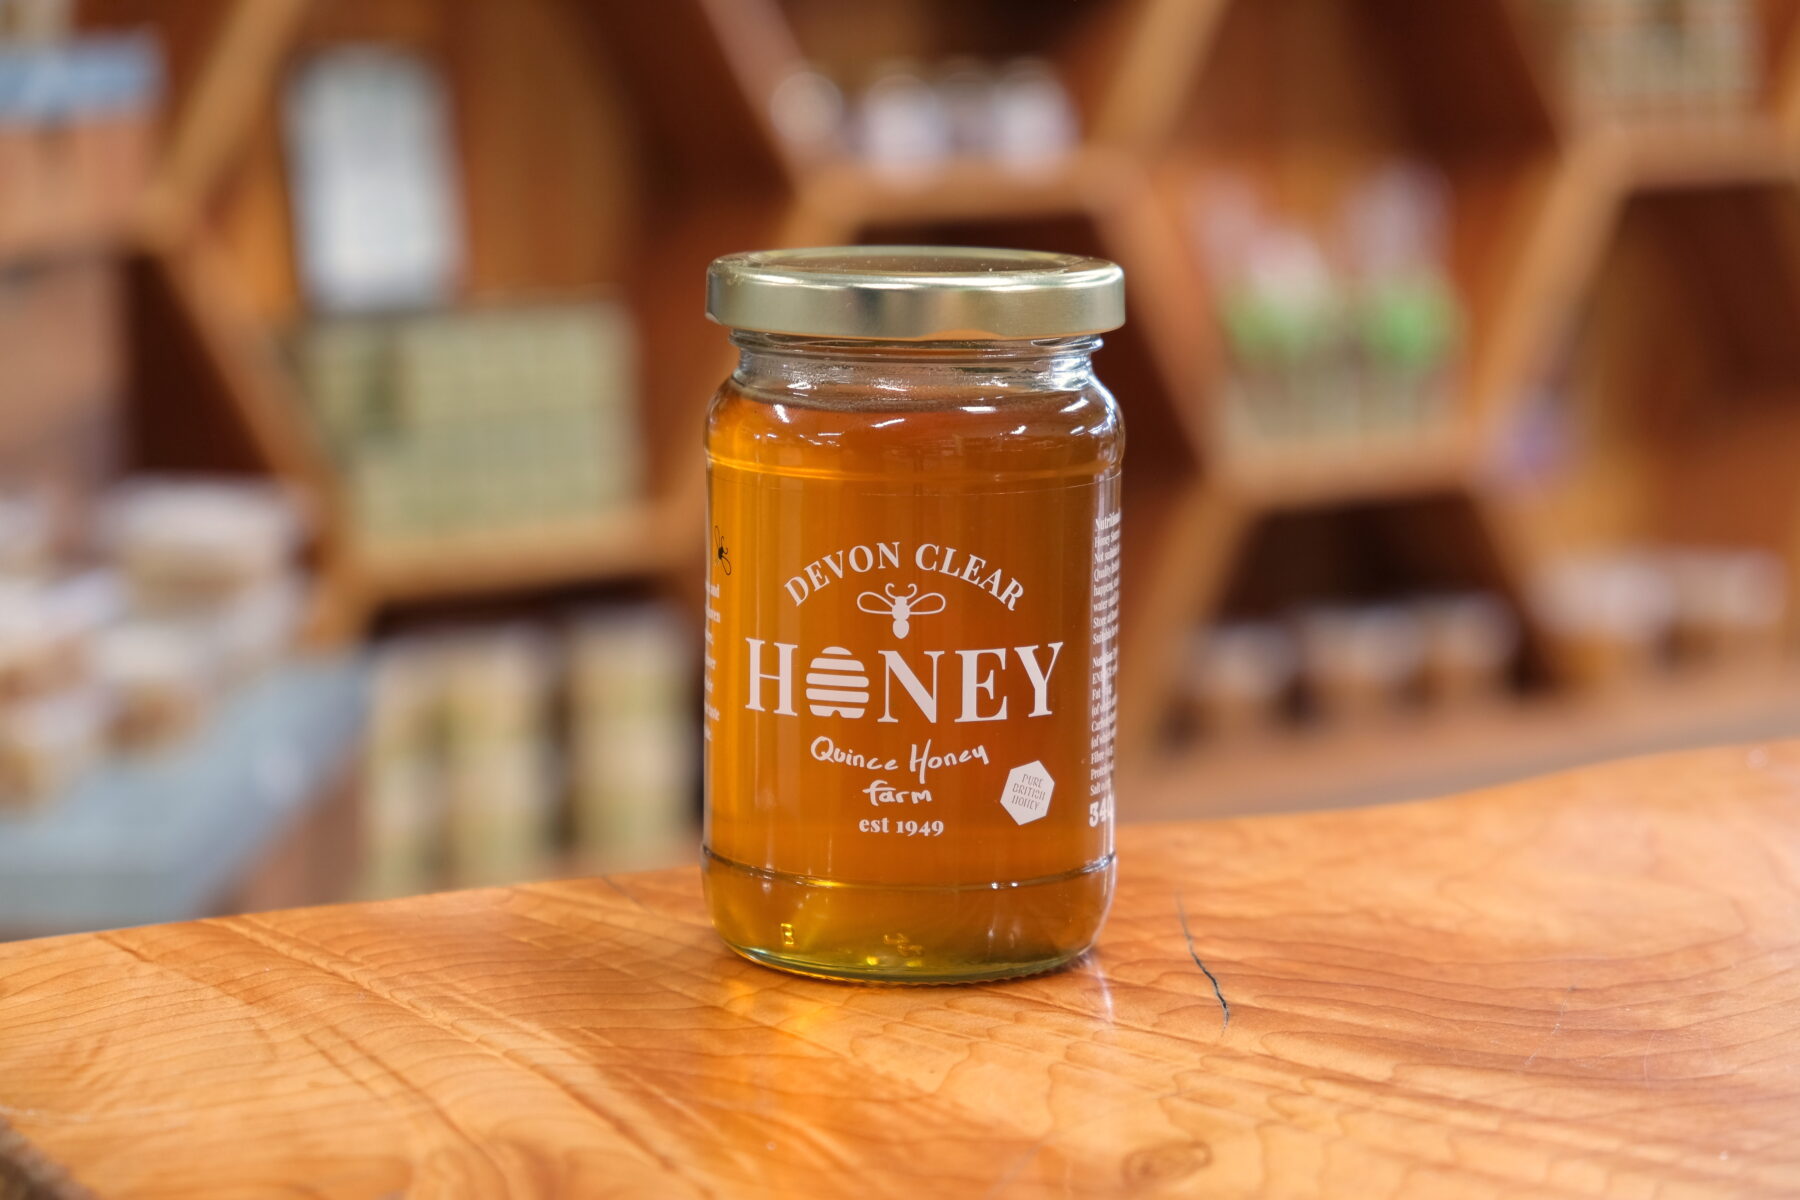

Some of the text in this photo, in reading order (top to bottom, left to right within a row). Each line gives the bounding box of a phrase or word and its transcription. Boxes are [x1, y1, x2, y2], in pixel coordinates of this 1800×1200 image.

[784, 541, 1024, 611] DEVON CLEAR
[810, 735, 990, 785] Quince Honey
[1021, 773, 1043, 788] PURE
[862, 778, 933, 807] farm
[1012, 782, 1046, 801] BRITISH
[1011, 794, 1040, 811] HONEY
[858, 817, 944, 837] est 1949
